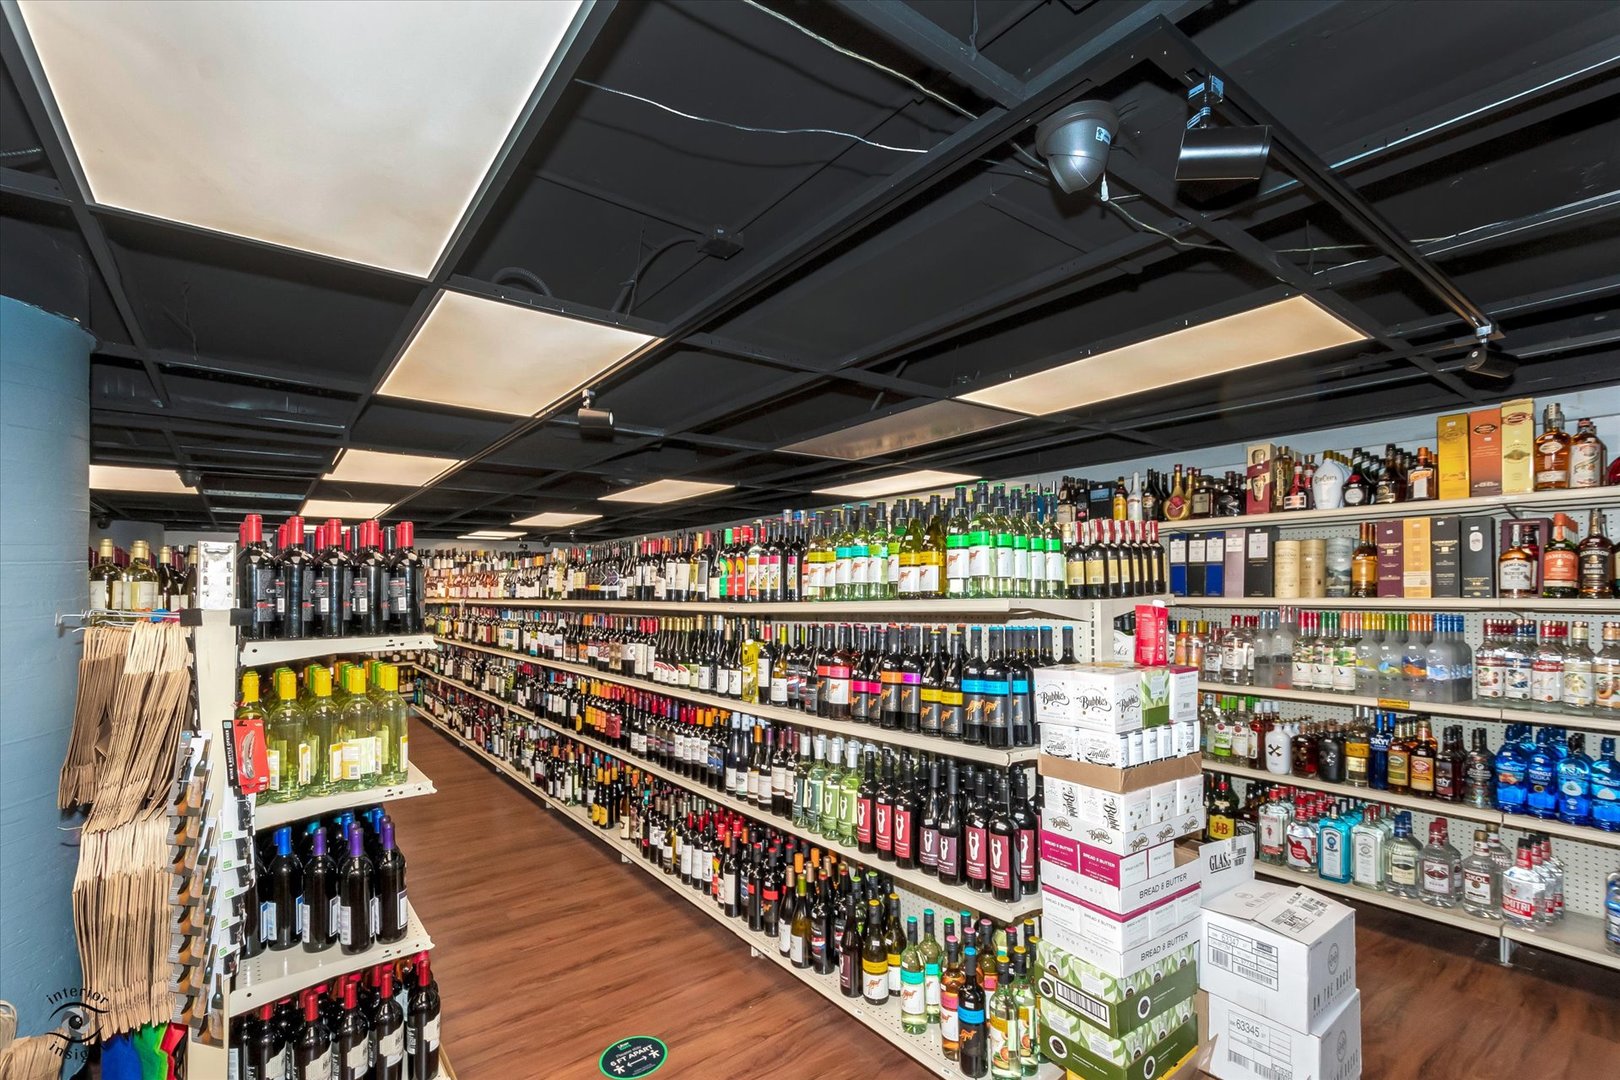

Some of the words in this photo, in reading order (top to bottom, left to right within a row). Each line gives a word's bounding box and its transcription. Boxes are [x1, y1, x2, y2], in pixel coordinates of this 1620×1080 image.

[1037, 691, 1070, 707] Bubbles
[1076, 695, 1112, 712] Bubbles
[1370, 737, 1389, 746] SKYY
[1214, 821, 1229, 835] J&B
[1139, 884, 1160, 899] BREAD
[1165, 872, 1188, 888] BUTTER
[1466, 872, 1489, 884] SKOL
[1140, 944, 1161, 961] BREAD
[1166, 931, 1189, 949] BUTTER
[1235, 1018, 1260, 1039] 63345
[616, 1055, 627, 1064] FT
[628, 1044, 653, 1059] APART
